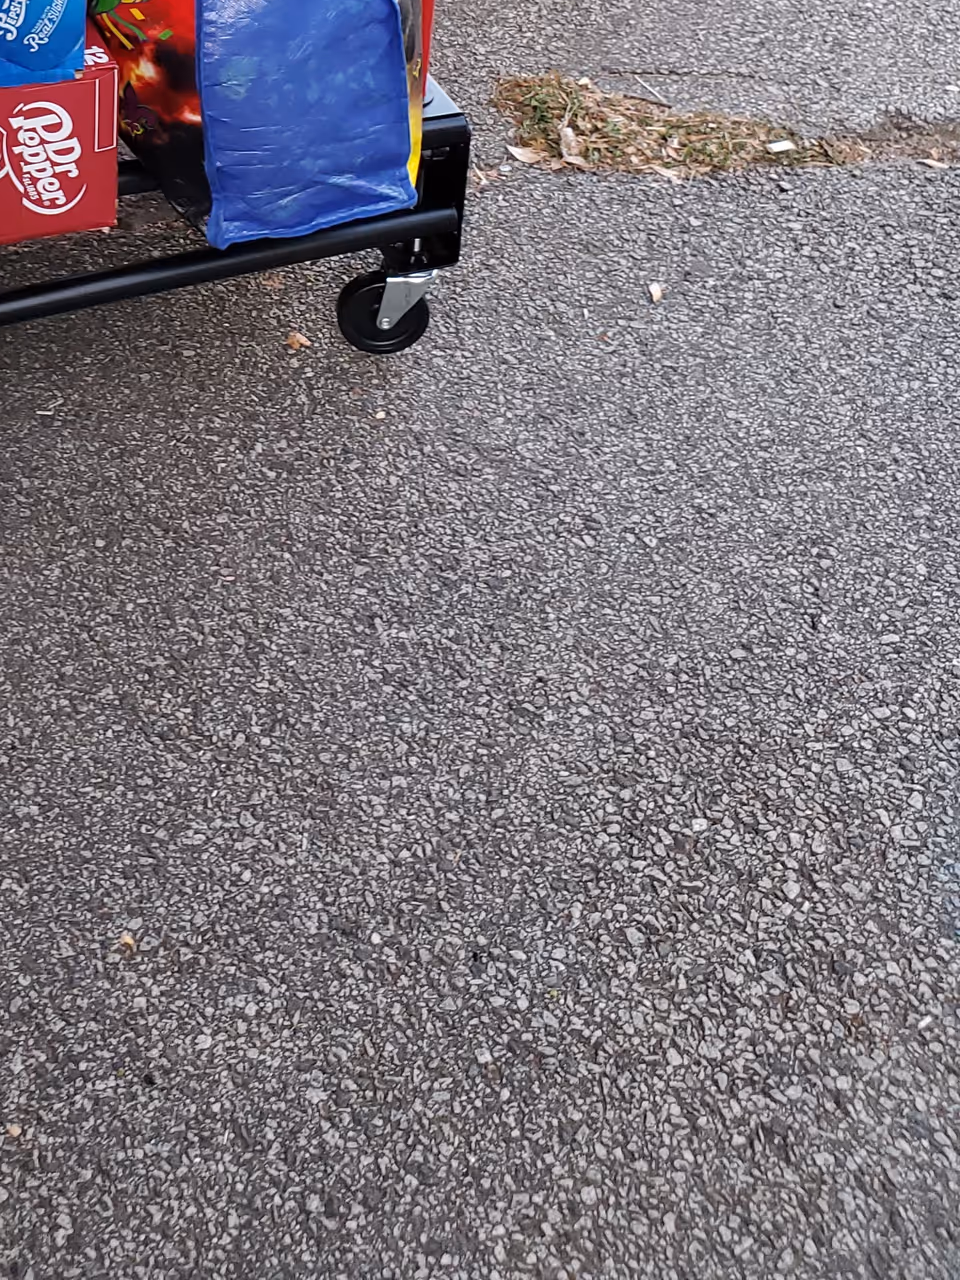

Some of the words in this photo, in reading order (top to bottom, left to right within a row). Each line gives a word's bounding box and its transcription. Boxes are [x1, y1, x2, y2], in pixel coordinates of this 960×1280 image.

[23, 22, 50, 53] Real
[86, 45, 109, 67] 12
[8, 102, 72, 204] Pepper
[44, 137, 81, 177] Dr
